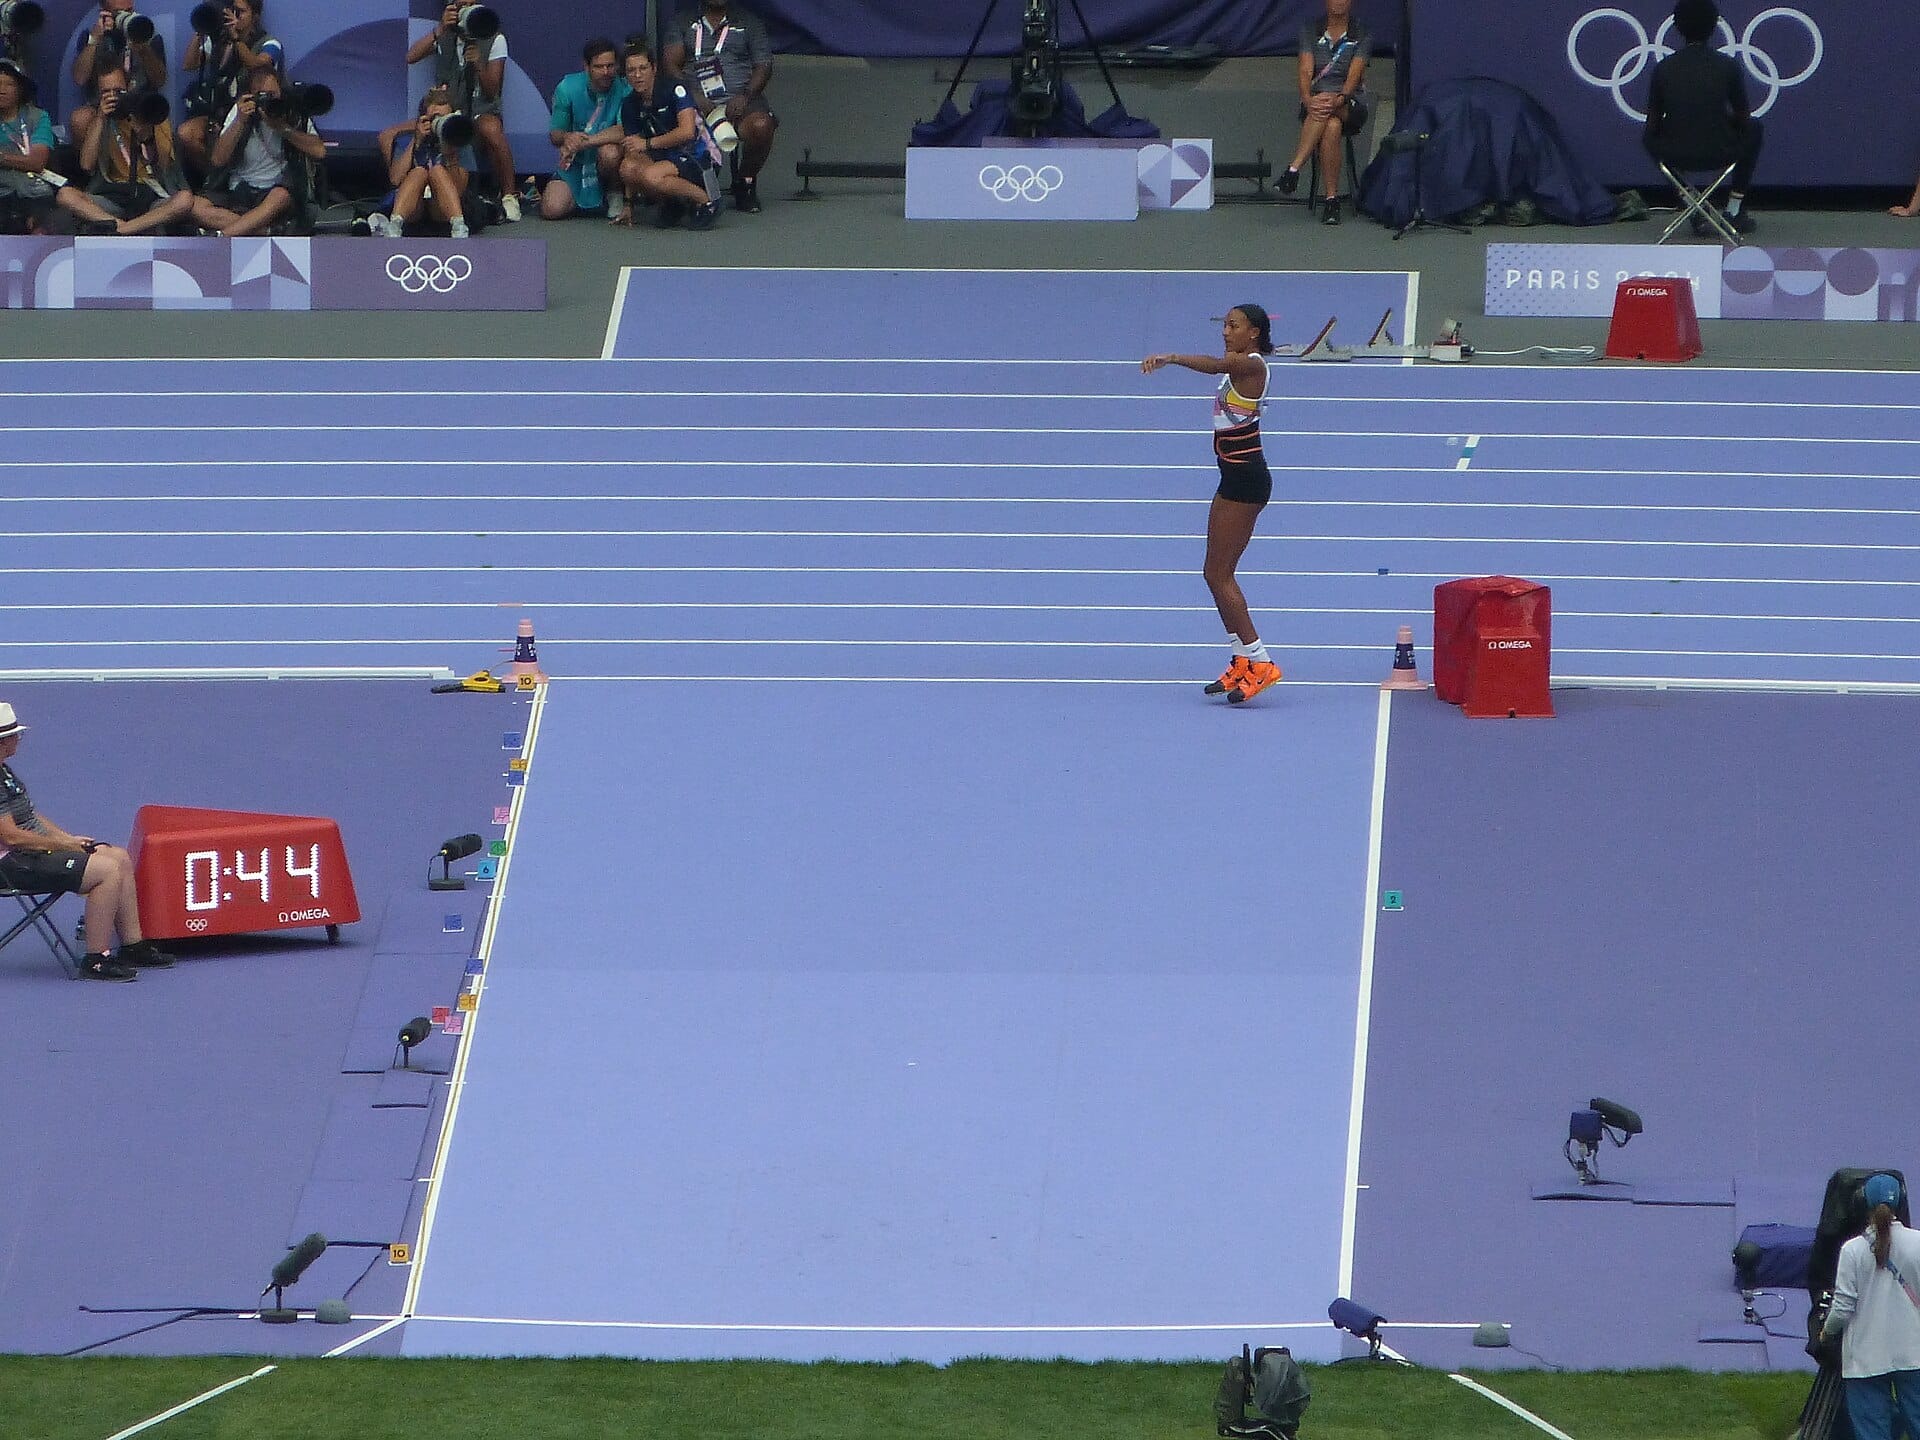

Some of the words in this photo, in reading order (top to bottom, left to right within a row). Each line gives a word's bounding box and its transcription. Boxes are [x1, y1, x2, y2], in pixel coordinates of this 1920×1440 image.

[1637, 288, 1669, 296] OMEGA
[1498, 640, 1533, 649] OMEGA
[520, 677, 532, 686] 10
[185, 843, 319, 911] 0:44
[290, 907, 331, 921] OMEGA
[393, 1249, 406, 1258] 10
